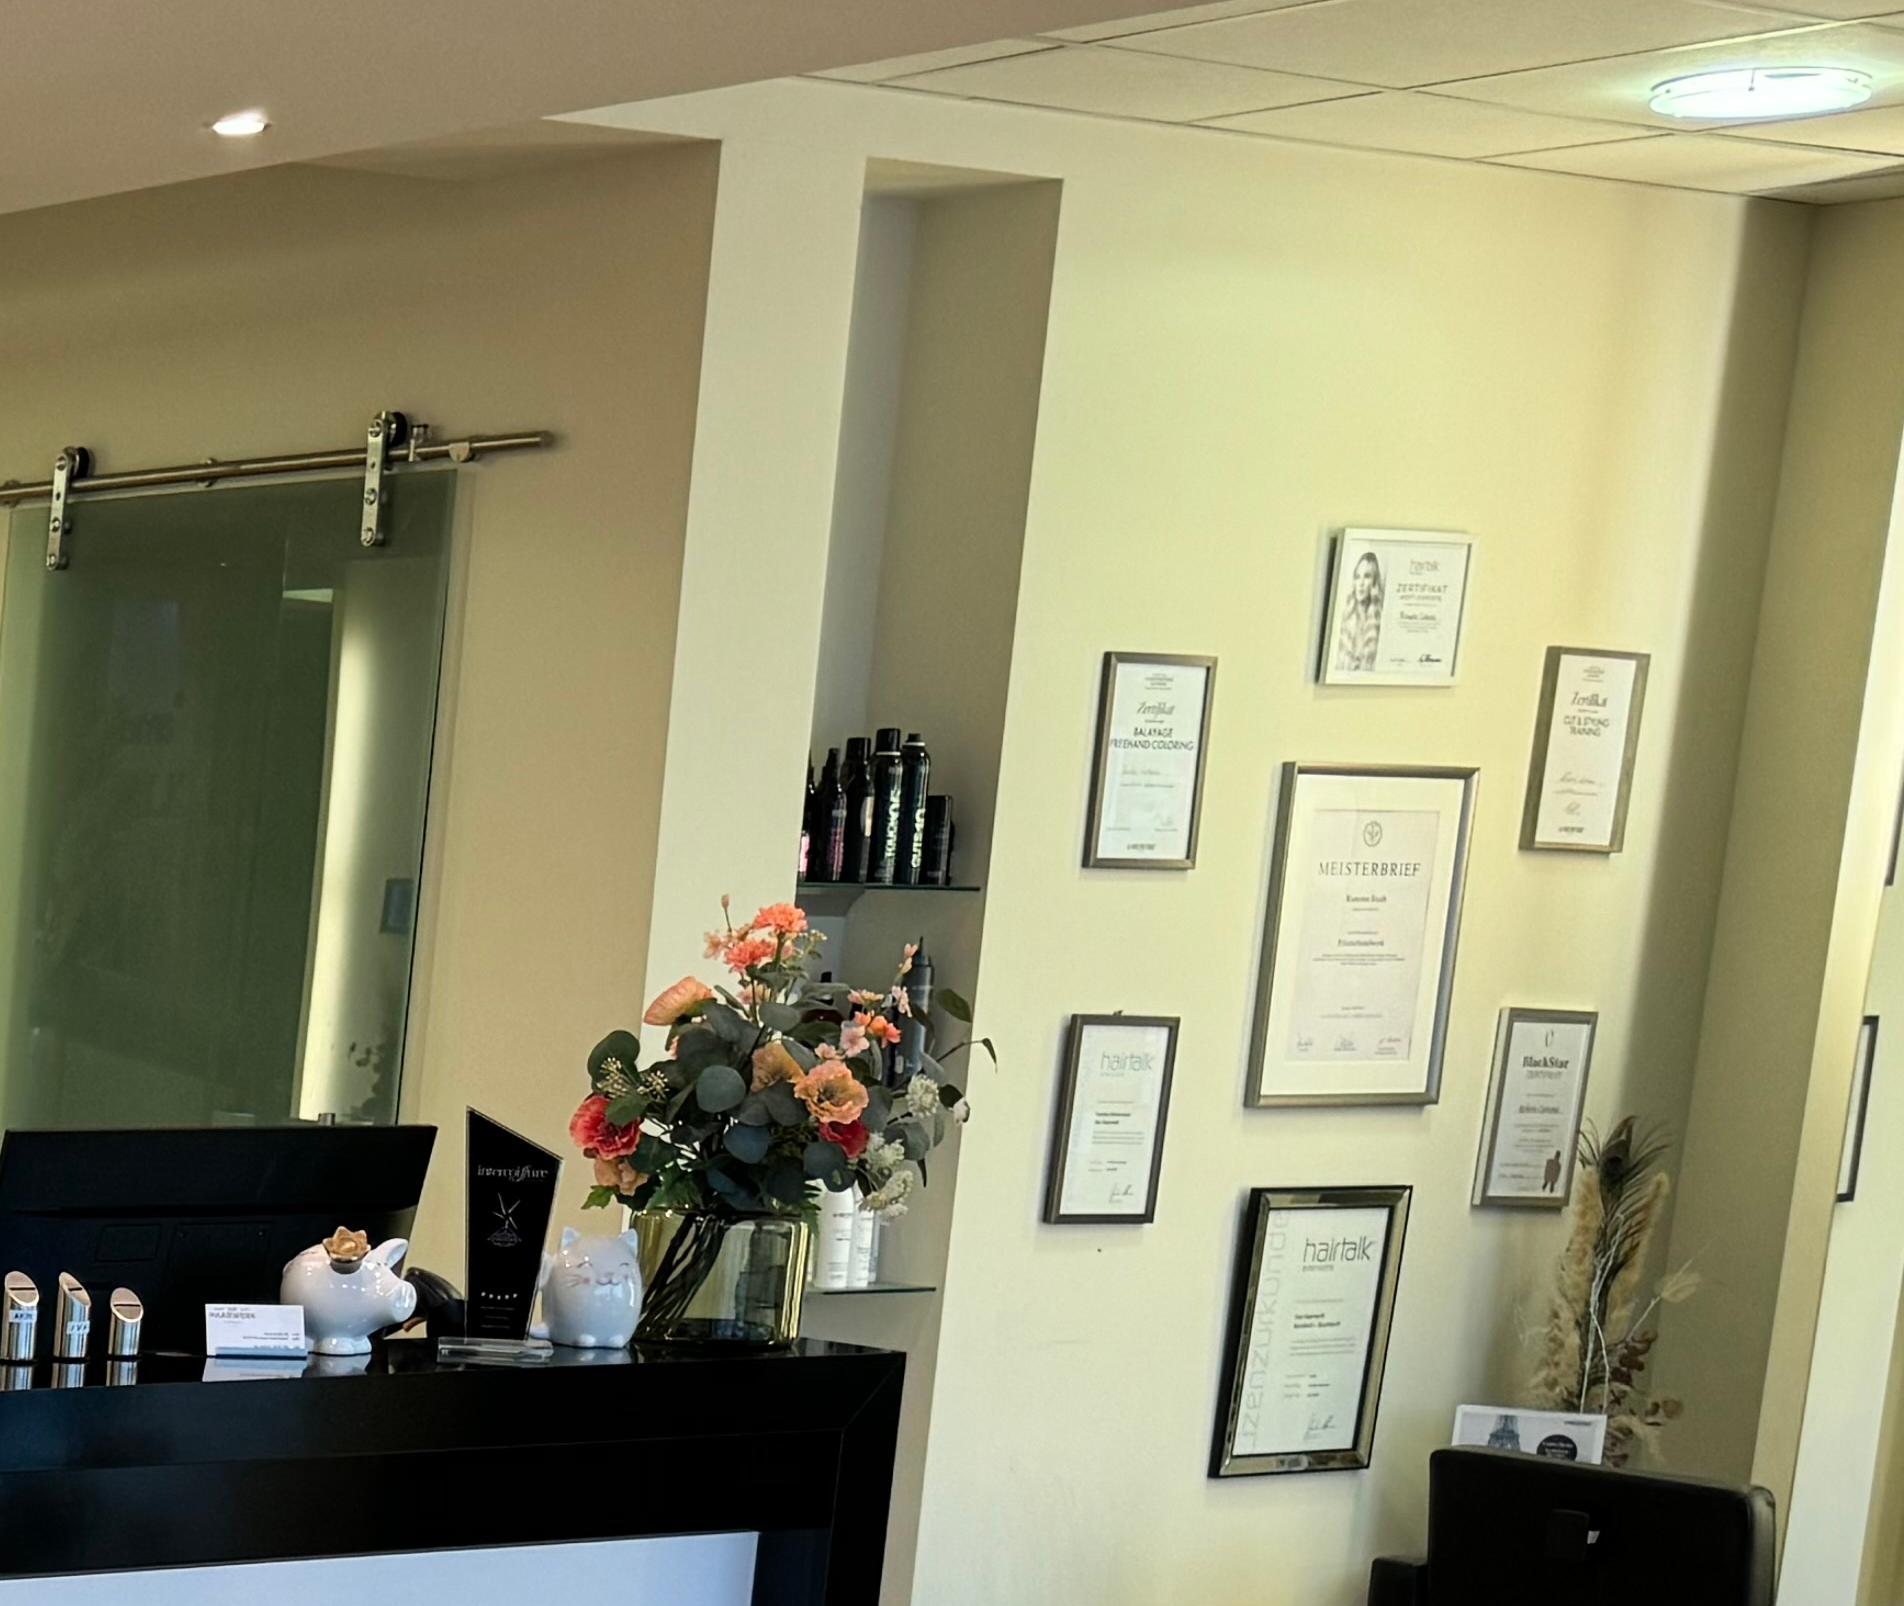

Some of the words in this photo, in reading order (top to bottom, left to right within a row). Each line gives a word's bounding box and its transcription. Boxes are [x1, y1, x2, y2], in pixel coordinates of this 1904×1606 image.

[1133, 727, 1174, 738] BALAYAGE
[1318, 861, 1422, 878] MEISTERBRIEF
[1100, 1051, 1154, 1073] hairtalk
[1522, 1056, 1569, 1070] BlackStar
[1302, 1235, 1375, 1264] hairtalk
